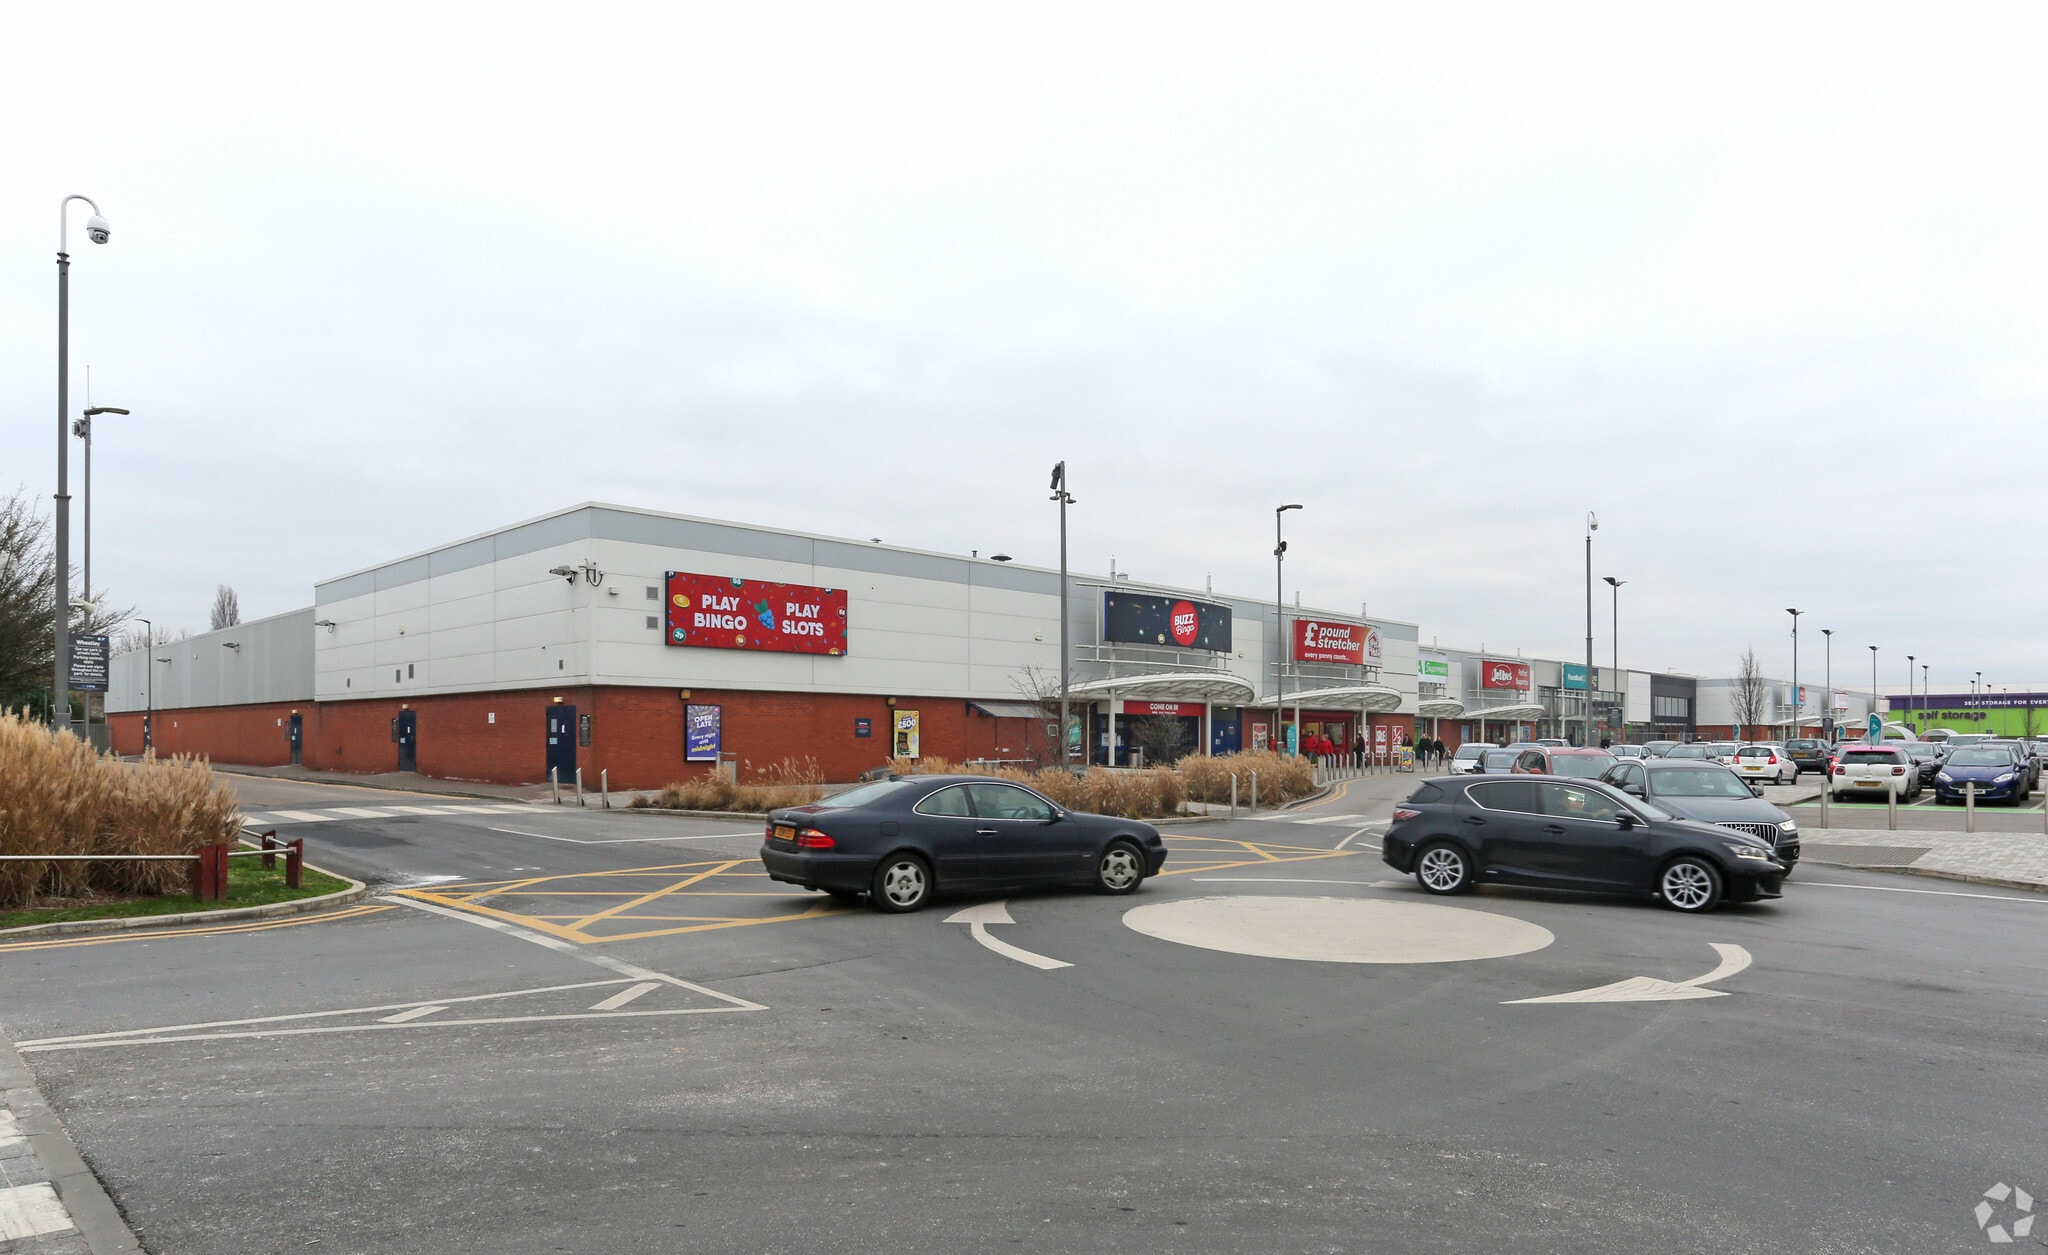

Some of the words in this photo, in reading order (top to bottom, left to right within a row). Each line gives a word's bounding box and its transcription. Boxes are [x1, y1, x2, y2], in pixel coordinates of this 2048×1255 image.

[701, 594, 740, 612] PLAY
[786, 602, 820, 618] PLAY
[694, 612, 747, 631] BINGO
[1174, 614, 1194, 626] BUZZ
[782, 620, 824, 637] SLOTS
[1176, 624, 1194, 636] Bingo
[1319, 627, 1350, 639] pound
[1317, 638, 1360, 652] stretcher
[694, 714, 713, 722] OPEN
[1918, 710, 1938, 720] self
[1942, 711, 1986, 722] storage
[898, 718, 917, 729] £500
[692, 744, 716, 752] midnight
